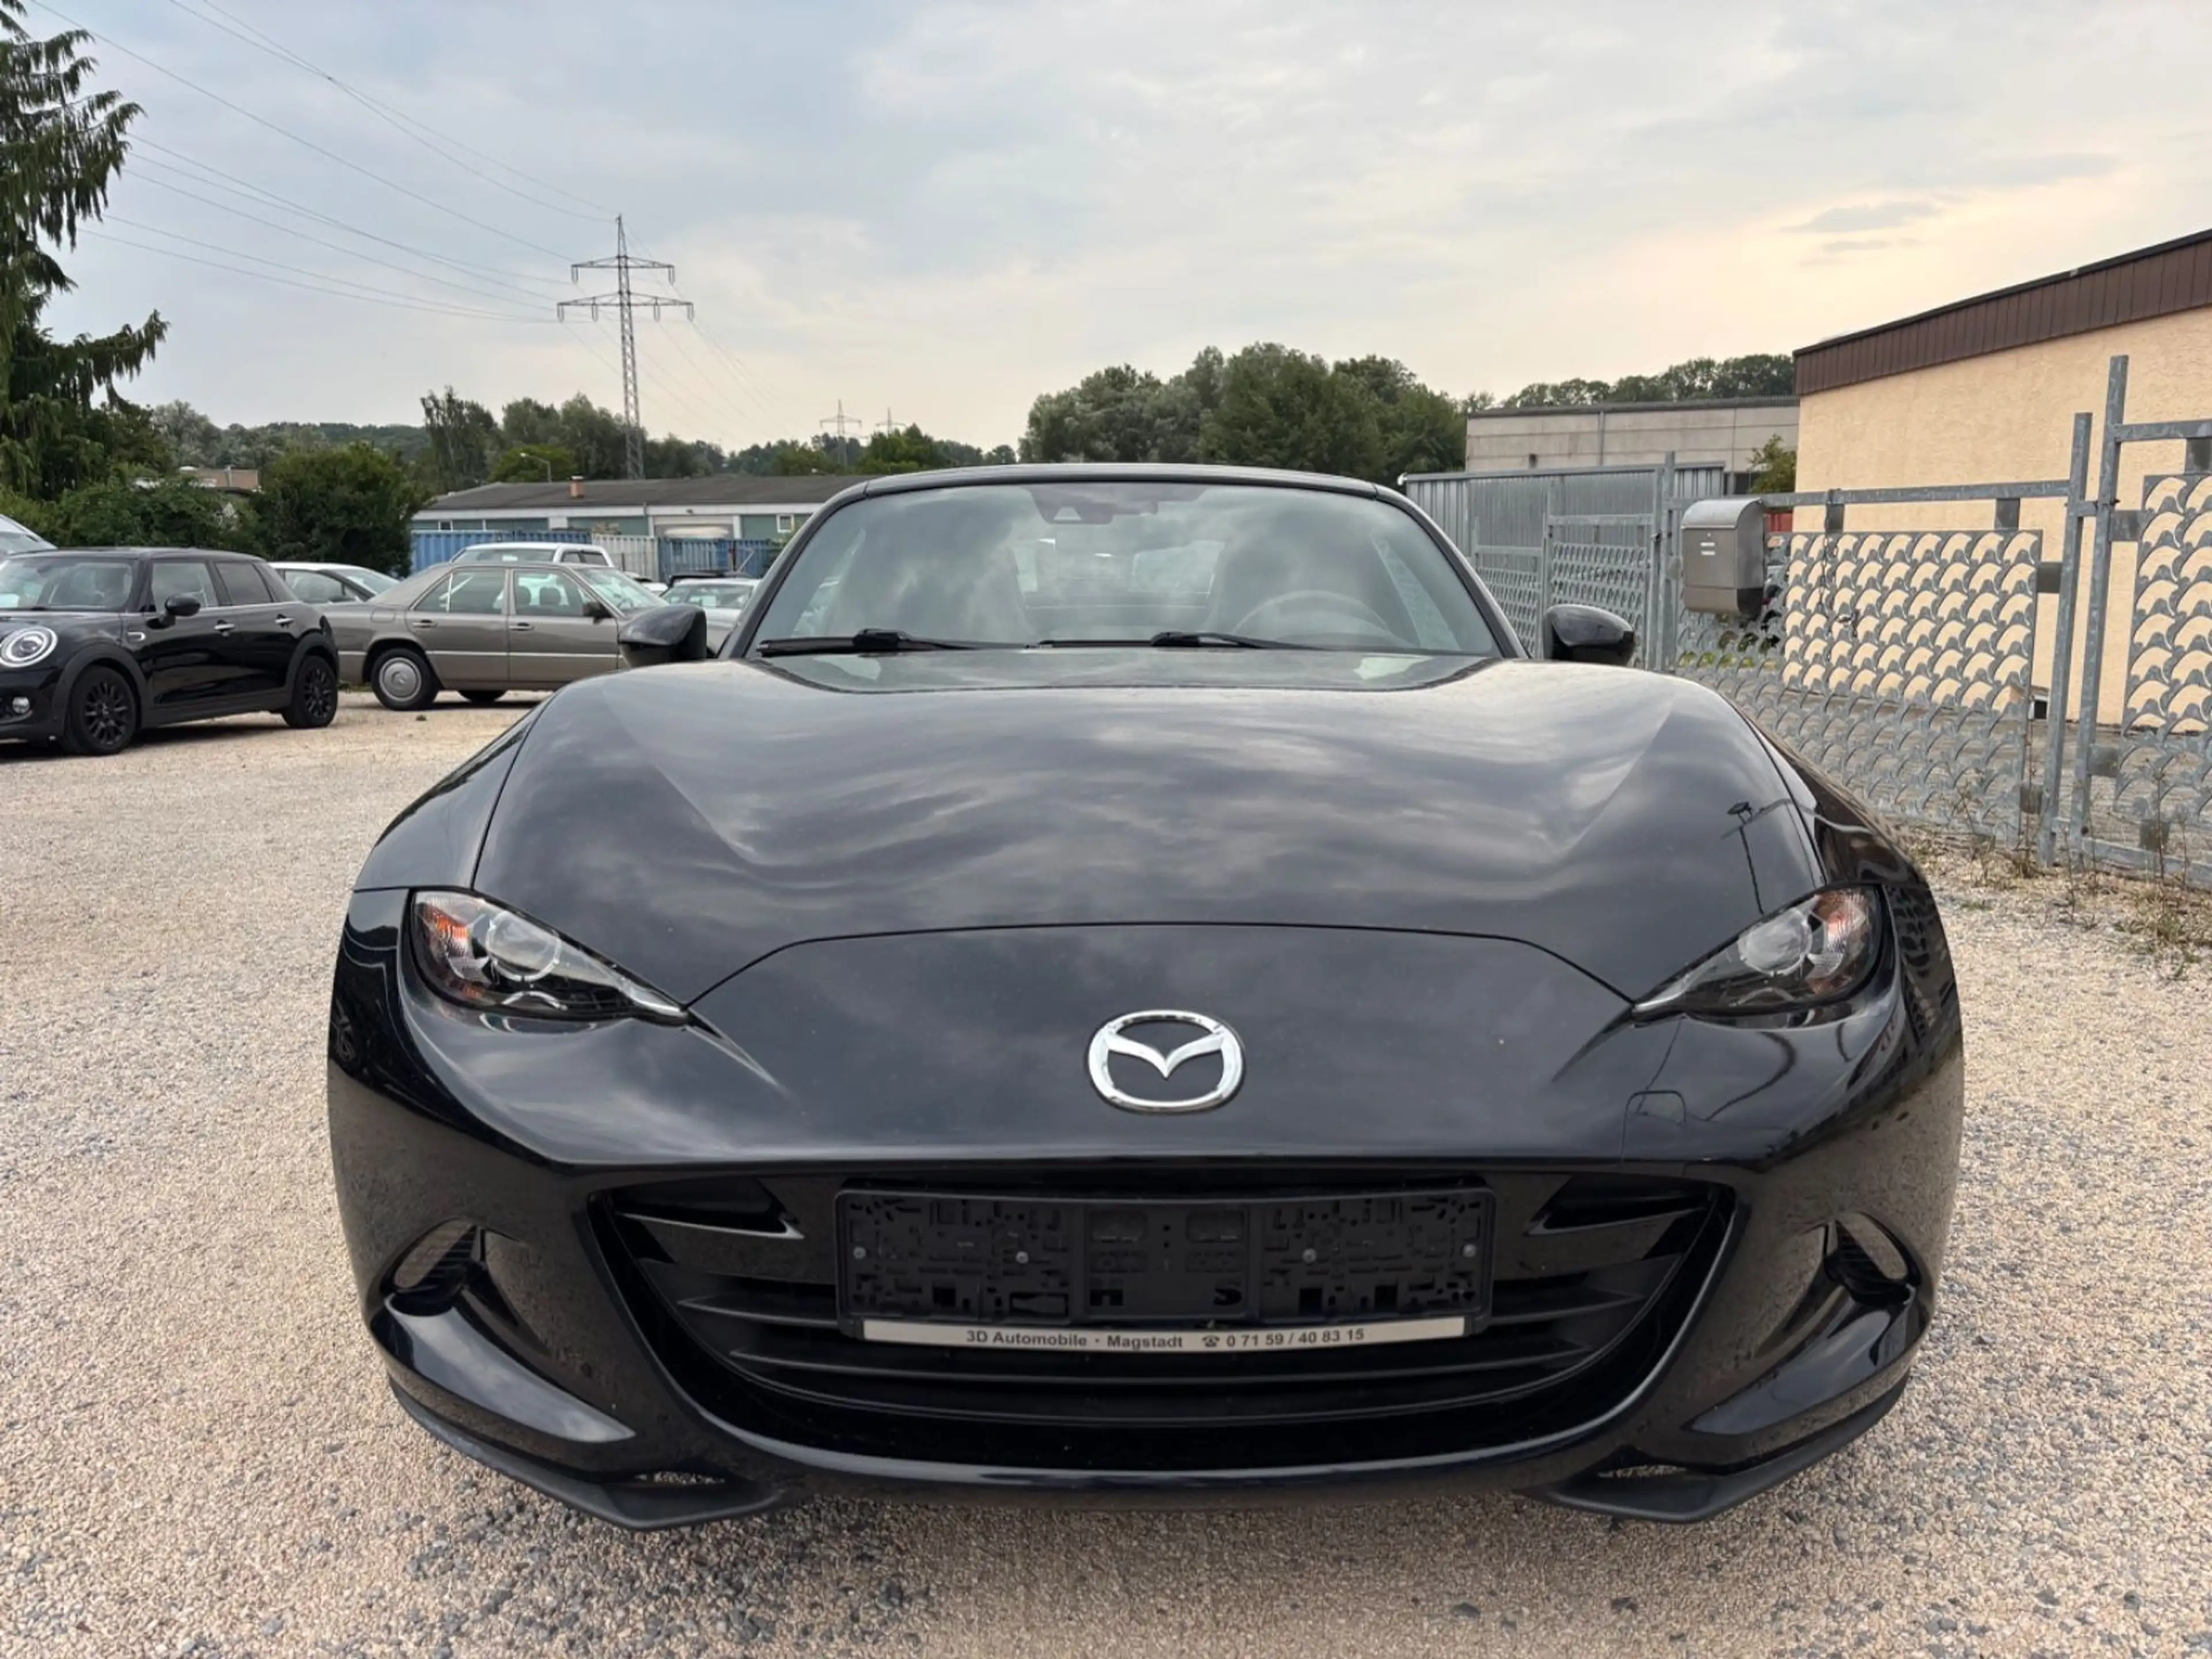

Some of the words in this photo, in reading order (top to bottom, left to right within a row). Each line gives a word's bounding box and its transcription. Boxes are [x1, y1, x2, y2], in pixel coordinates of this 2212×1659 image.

[966, 1330, 988, 1343] 3D
[992, 1331, 1088, 1347] Automobile
[1107, 1335, 1183, 1351] Magstadt
[1226, 1335, 1236, 1347] 0
[1241, 1334, 1259, 1347] 71
[1265, 1333, 1285, 1346] 59
[1297, 1331, 1317, 1344] 40
[1347, 1328, 1365, 1342] 15
